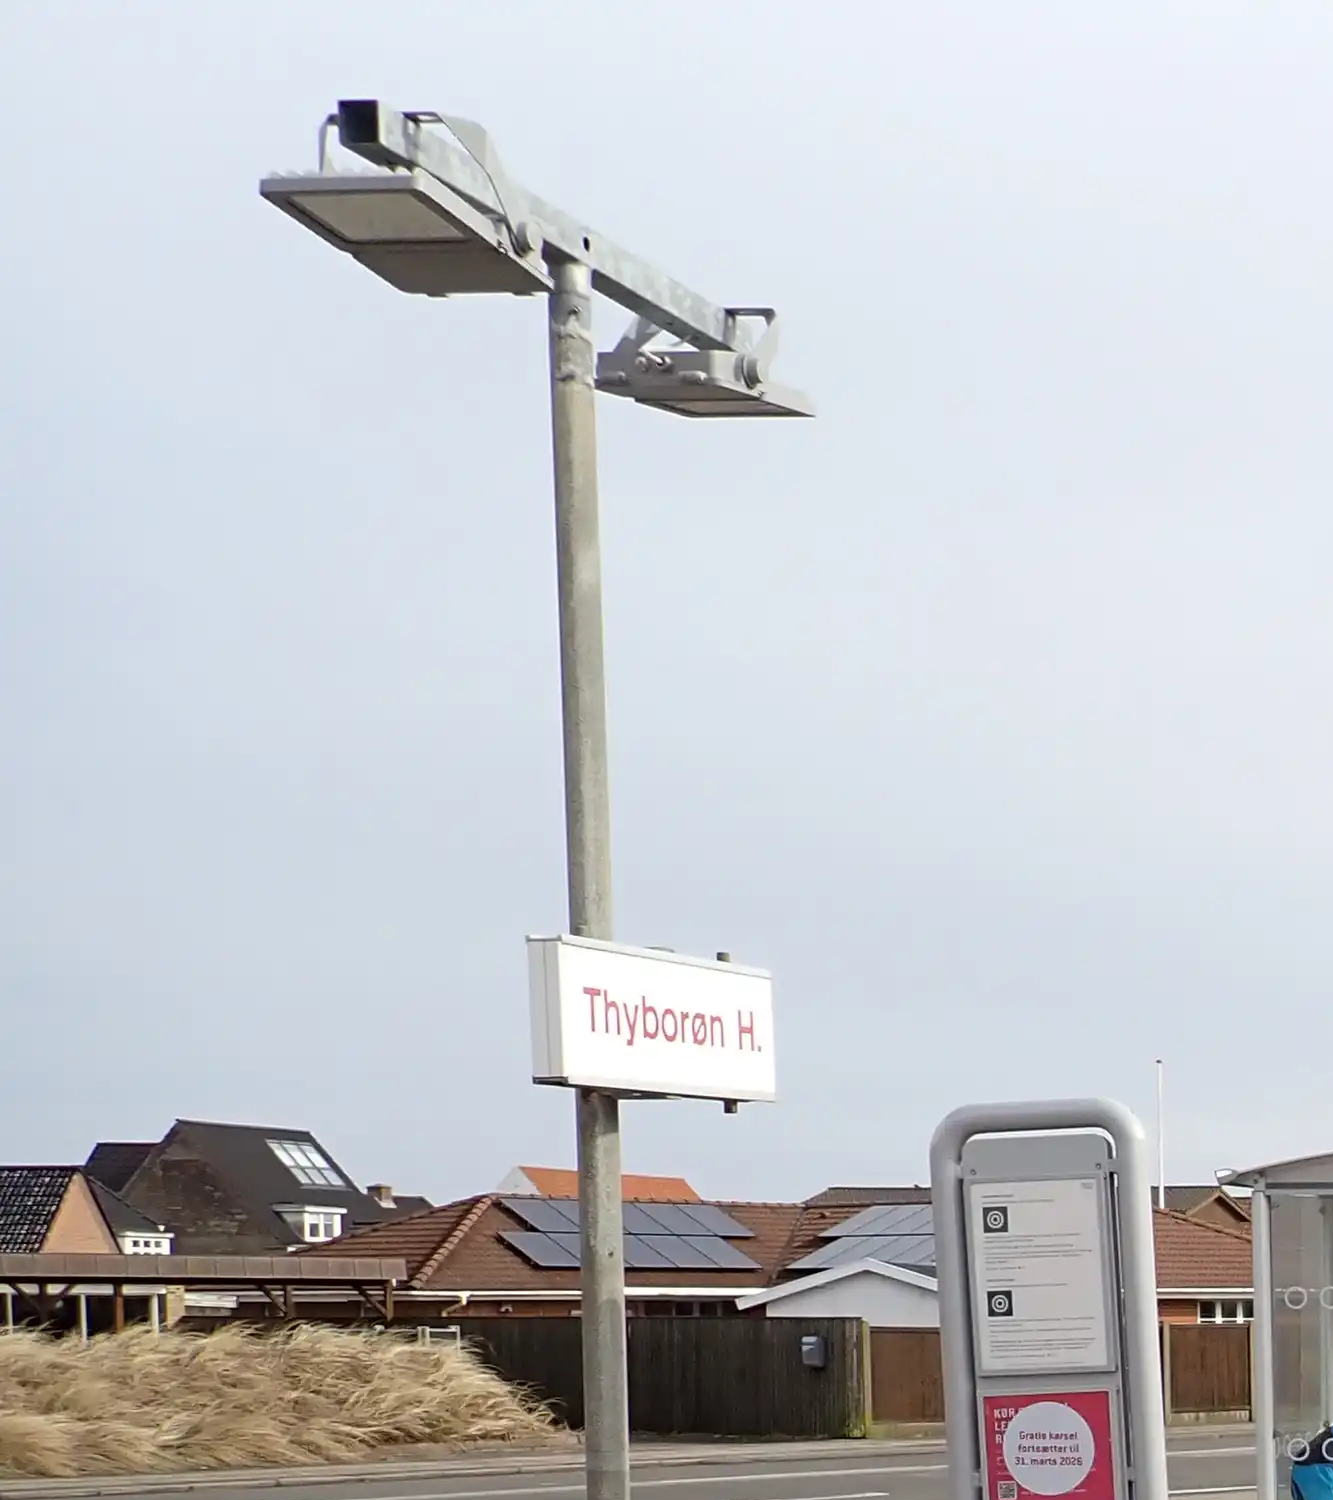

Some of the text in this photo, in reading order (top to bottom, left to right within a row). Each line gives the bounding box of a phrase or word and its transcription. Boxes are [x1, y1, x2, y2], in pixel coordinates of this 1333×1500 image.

[582, 986, 762, 1052] Thyborøn H.
[1019, 1430, 1047, 1440] Gratis
[1017, 1444, 1070, 1453] fortsætter
[1014, 1456, 1028, 1466] 31.
[1030, 1457, 1057, 1466] marts
